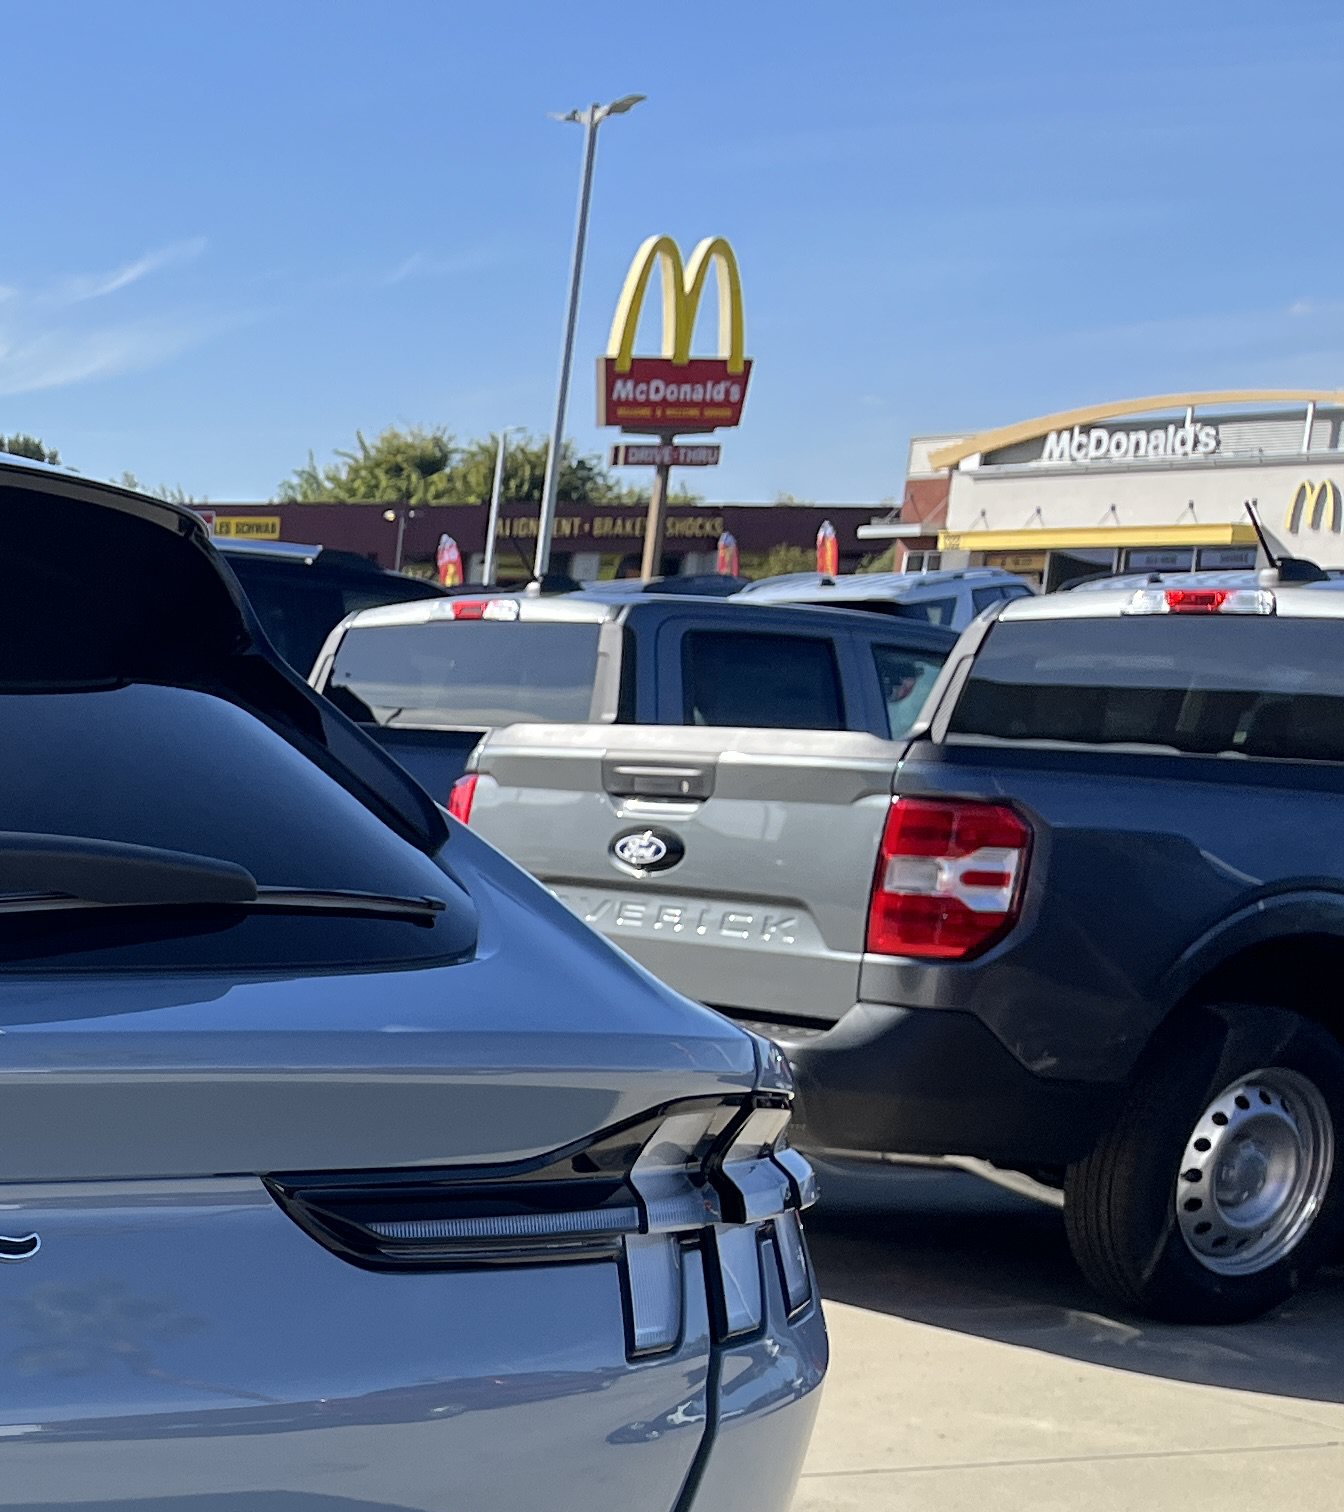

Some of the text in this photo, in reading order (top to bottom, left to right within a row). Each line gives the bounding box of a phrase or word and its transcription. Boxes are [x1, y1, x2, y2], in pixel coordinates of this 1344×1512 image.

[612, 379, 741, 403] McDonald's
[1040, 423, 1217, 461] McDonald's
[496, 516, 582, 538] ALIGNENT
[592, 516, 648, 538] BRAKE
